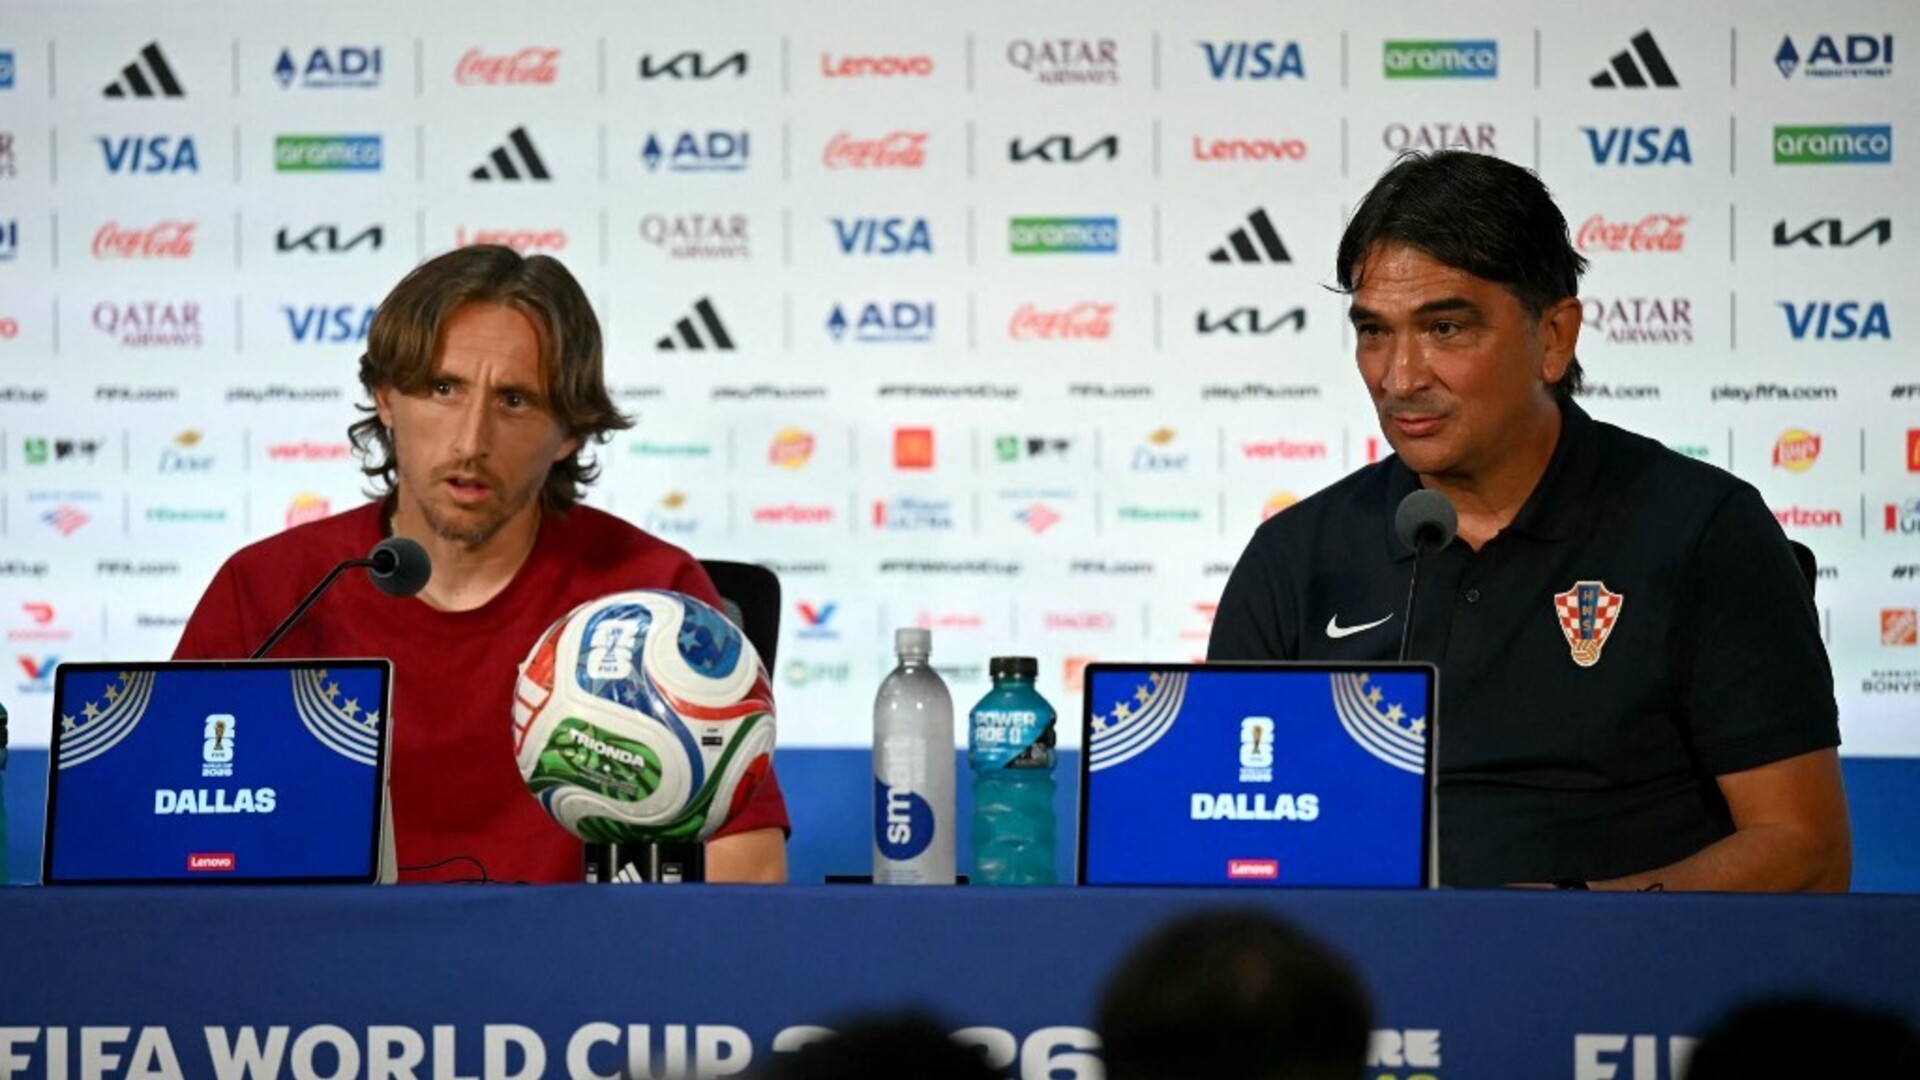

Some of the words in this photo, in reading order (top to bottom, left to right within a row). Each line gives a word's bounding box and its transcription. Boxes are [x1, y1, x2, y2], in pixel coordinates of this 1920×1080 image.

[304, 47, 382, 76] ADI
[1007, 39, 1117, 72] QATAR
[1200, 41, 1305, 80] VISA
[1385, 45, 1496, 75] aramco
[1806, 33, 1894, 65] ADI
[822, 53, 934, 78] Lenovo
[672, 132, 749, 160] ADI
[1193, 136, 1307, 161] Lenovo
[1383, 123, 1497, 152] QATAR
[1583, 126, 1692, 165] VISA
[1776, 132, 1888, 158] aramco
[97, 136, 198, 173] VISA
[277, 139, 380, 167] aramco
[640, 214, 750, 241] QATAR
[831, 217, 933, 255] VISA
[1012, 223, 1116, 247] aramco
[93, 302, 200, 333] QATAR
[858, 303, 934, 330] ADI
[1780, 301, 1891, 340] VISA
[1241, 440, 1327, 458] verizon
[752, 504, 834, 523] verizon
[974, 710, 1036, 727] POWER
[569, 727, 645, 769] TRIONDA
[155, 788, 276, 814] DALLAS
[1191, 793, 1319, 821] DALLAS
[191, 857, 231, 867] Lenovo
[1231, 863, 1274, 875] Lenovo
[0, 1026, 184, 1080] FIFA
[204, 1024, 545, 1080] WORLD
[566, 1022, 753, 1080] CUP
